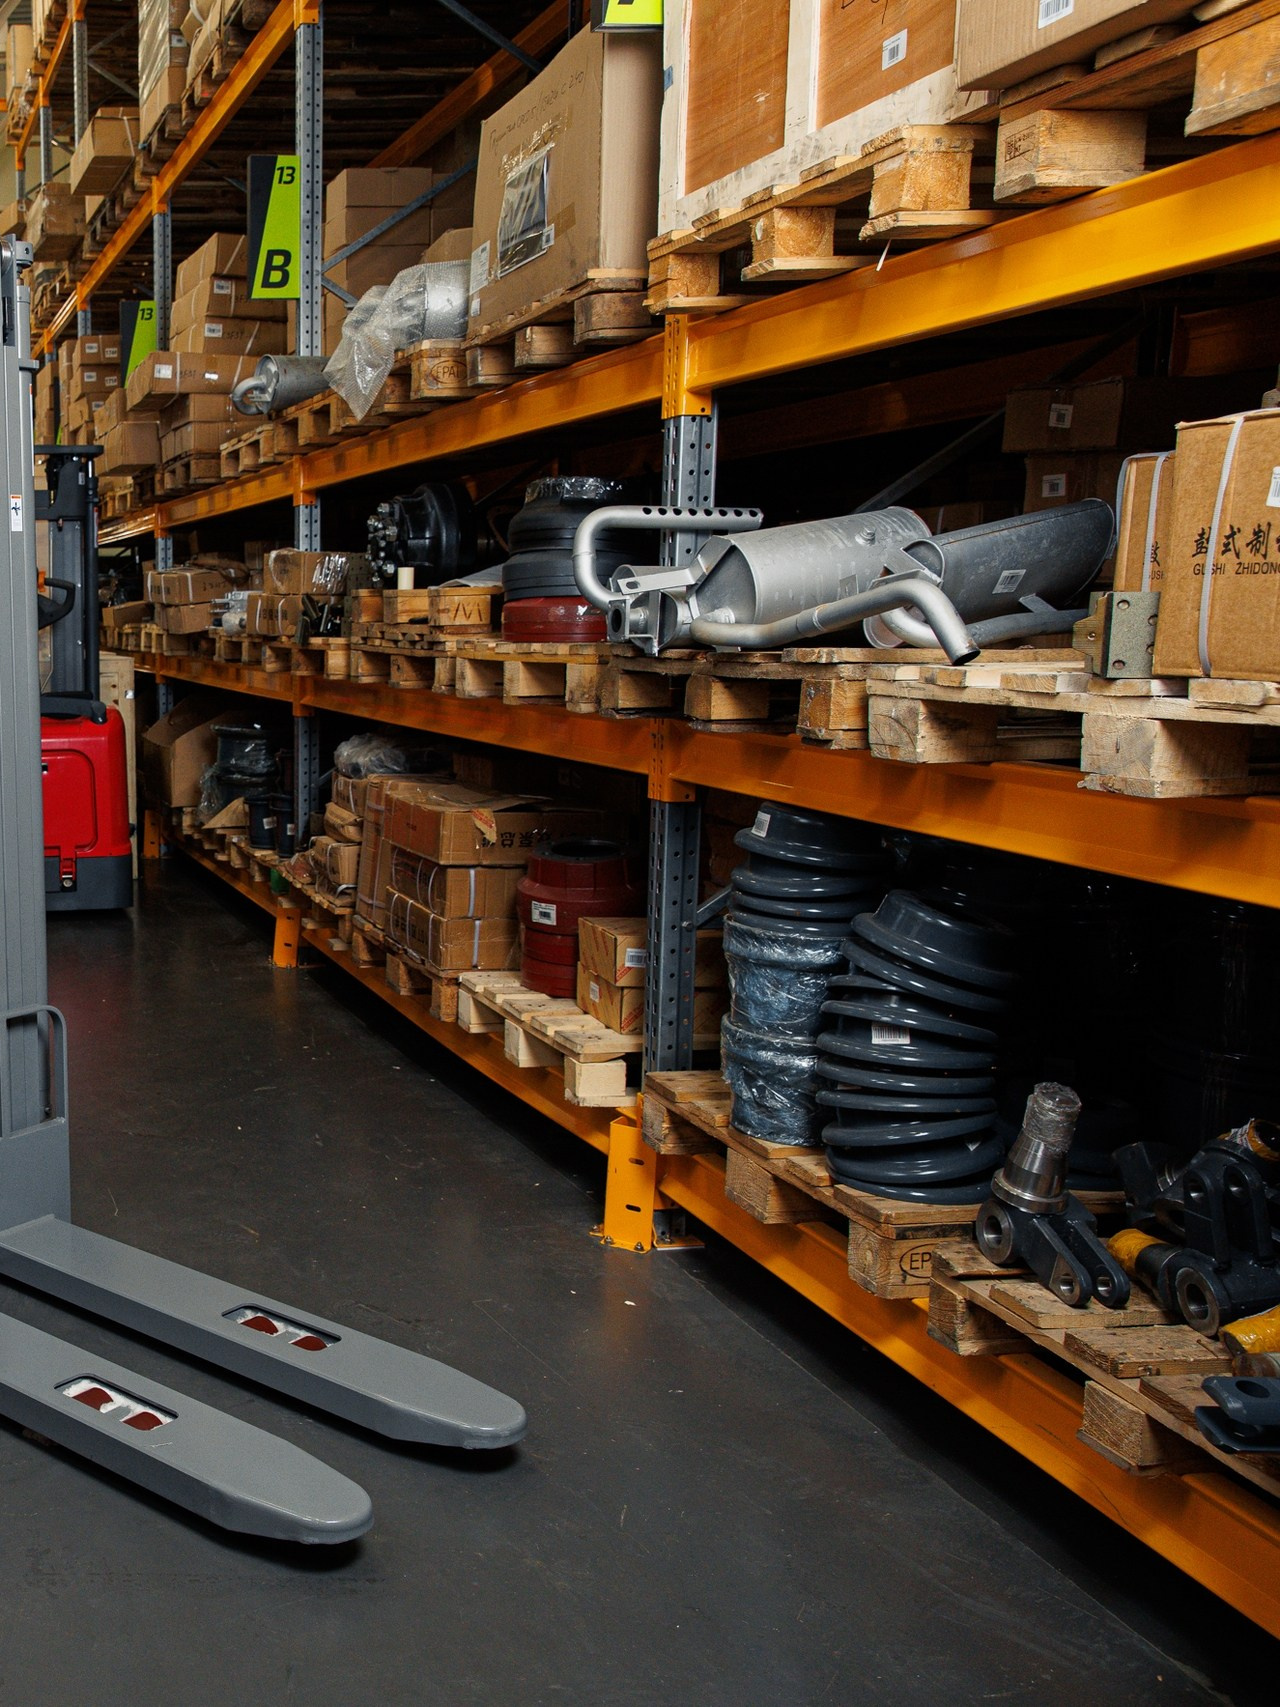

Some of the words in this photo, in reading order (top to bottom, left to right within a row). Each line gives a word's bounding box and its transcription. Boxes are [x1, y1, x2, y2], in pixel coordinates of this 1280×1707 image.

[276, 166, 296, 185] 13
[260, 249, 292, 289] B
[139, 308, 154, 321] 13
[436, 365, 465, 379] EPAL
[1235, 562, 1280, 575] ZHIDON
[910, 1252, 932, 1270] EP
